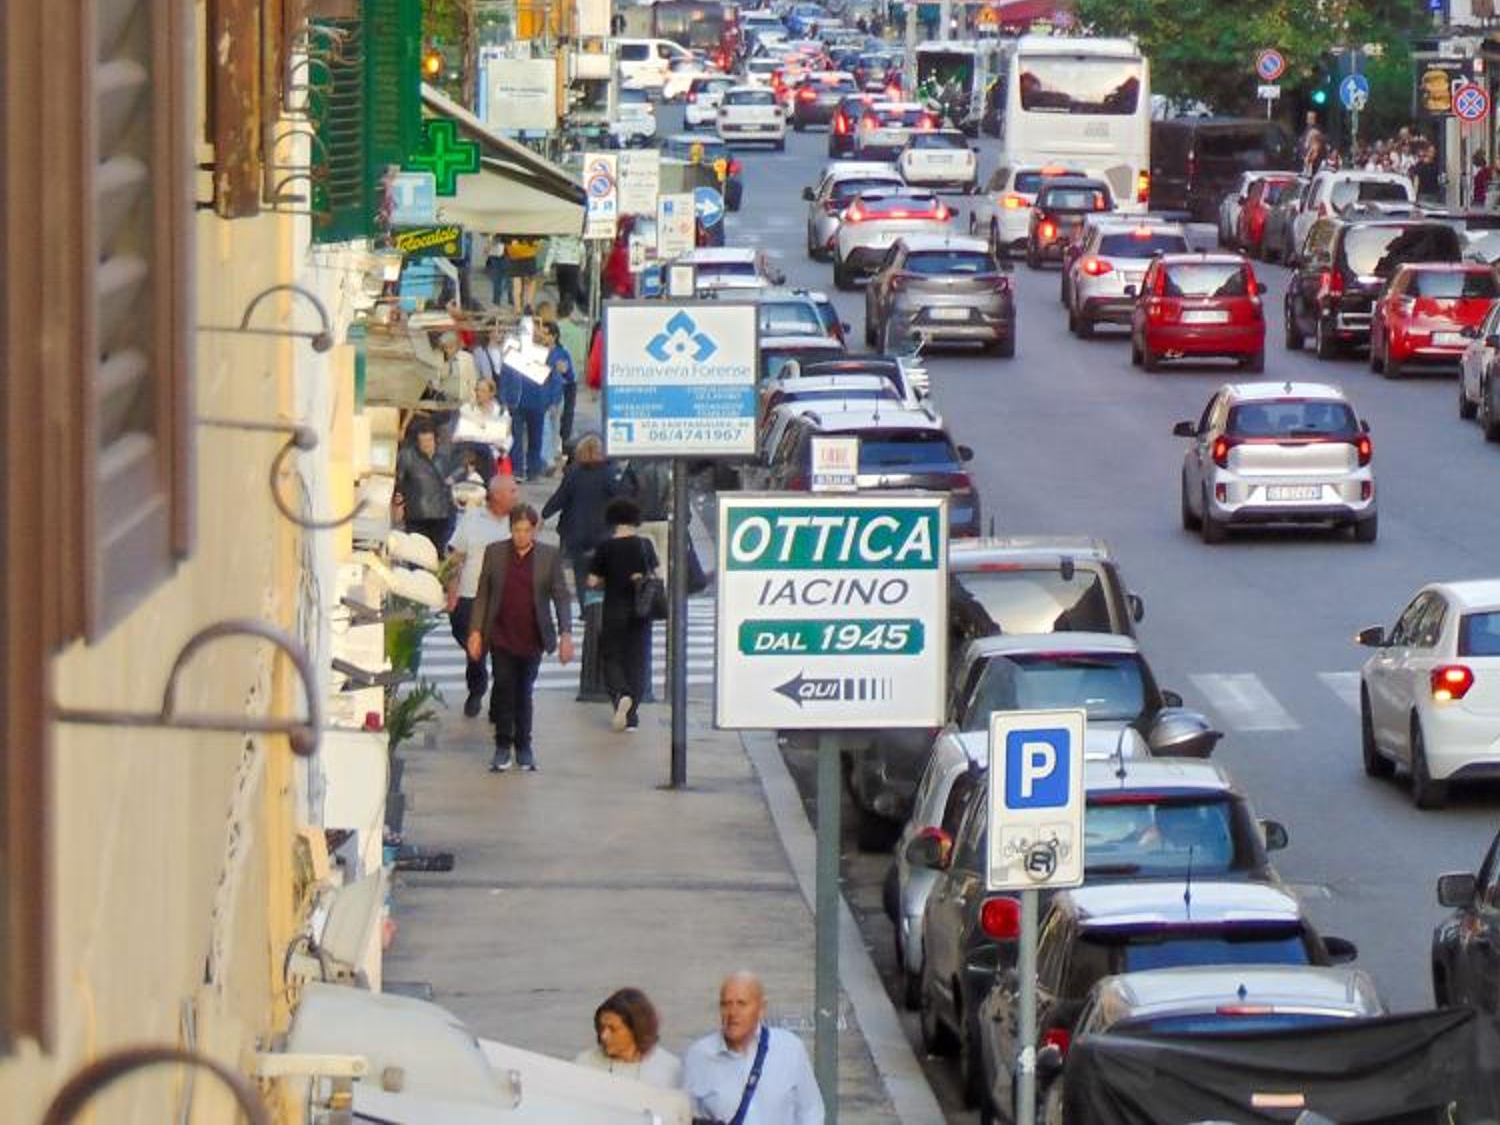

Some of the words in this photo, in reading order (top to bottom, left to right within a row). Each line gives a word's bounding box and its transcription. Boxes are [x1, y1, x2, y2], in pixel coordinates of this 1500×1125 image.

[610, 362, 688, 379] Primavera
[691, 362, 751, 378] Forense
[649, 429, 742, 442] 06/4741967
[731, 515, 933, 563] OTTICA
[757, 578, 910, 606] IACINO
[754, 631, 808, 651] DAL
[820, 624, 911, 651] 1945
[798, 682, 839, 698] QUI
[1020, 741, 1057, 798] P
